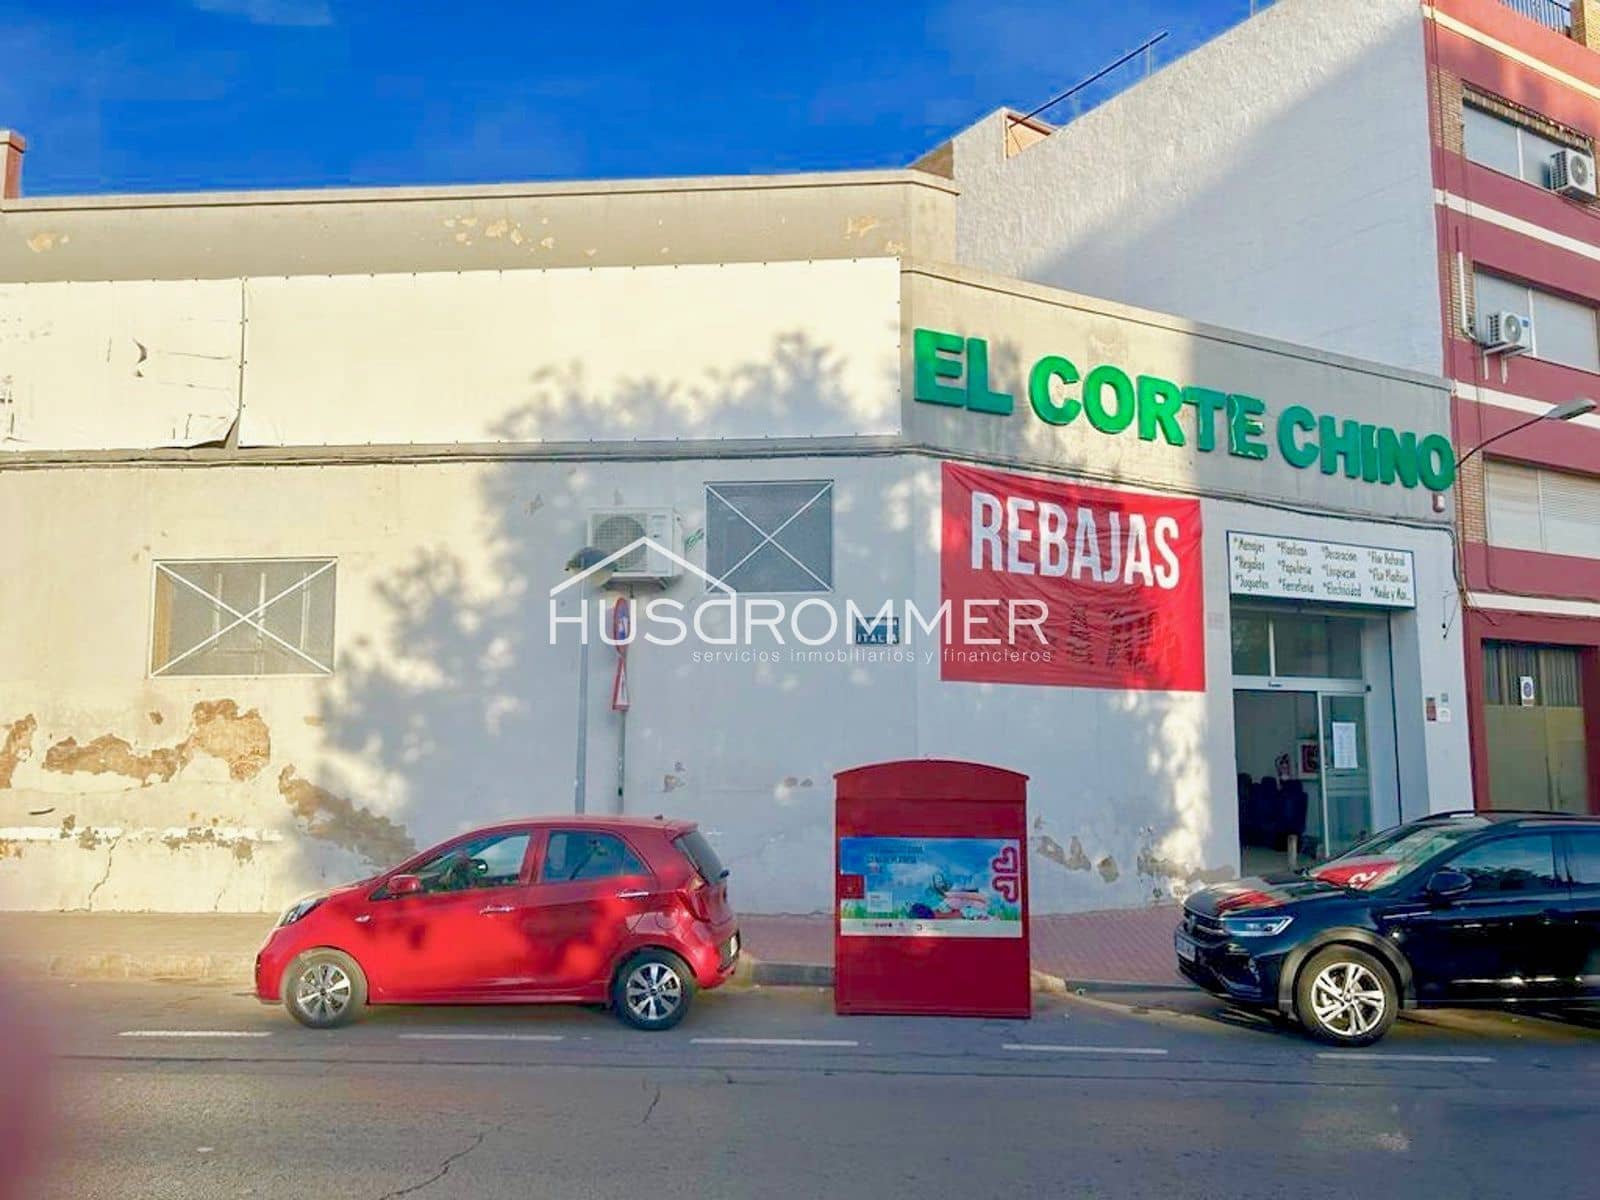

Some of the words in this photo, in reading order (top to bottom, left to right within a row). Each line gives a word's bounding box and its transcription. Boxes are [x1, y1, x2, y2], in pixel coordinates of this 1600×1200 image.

[913, 327, 1013, 417] EL
[1028, 354, 1268, 460] CORTE
[1277, 403, 1456, 492] CHINO
[970, 490, 1181, 590] REBAJAS
[857, 633, 898, 643] ITALA
